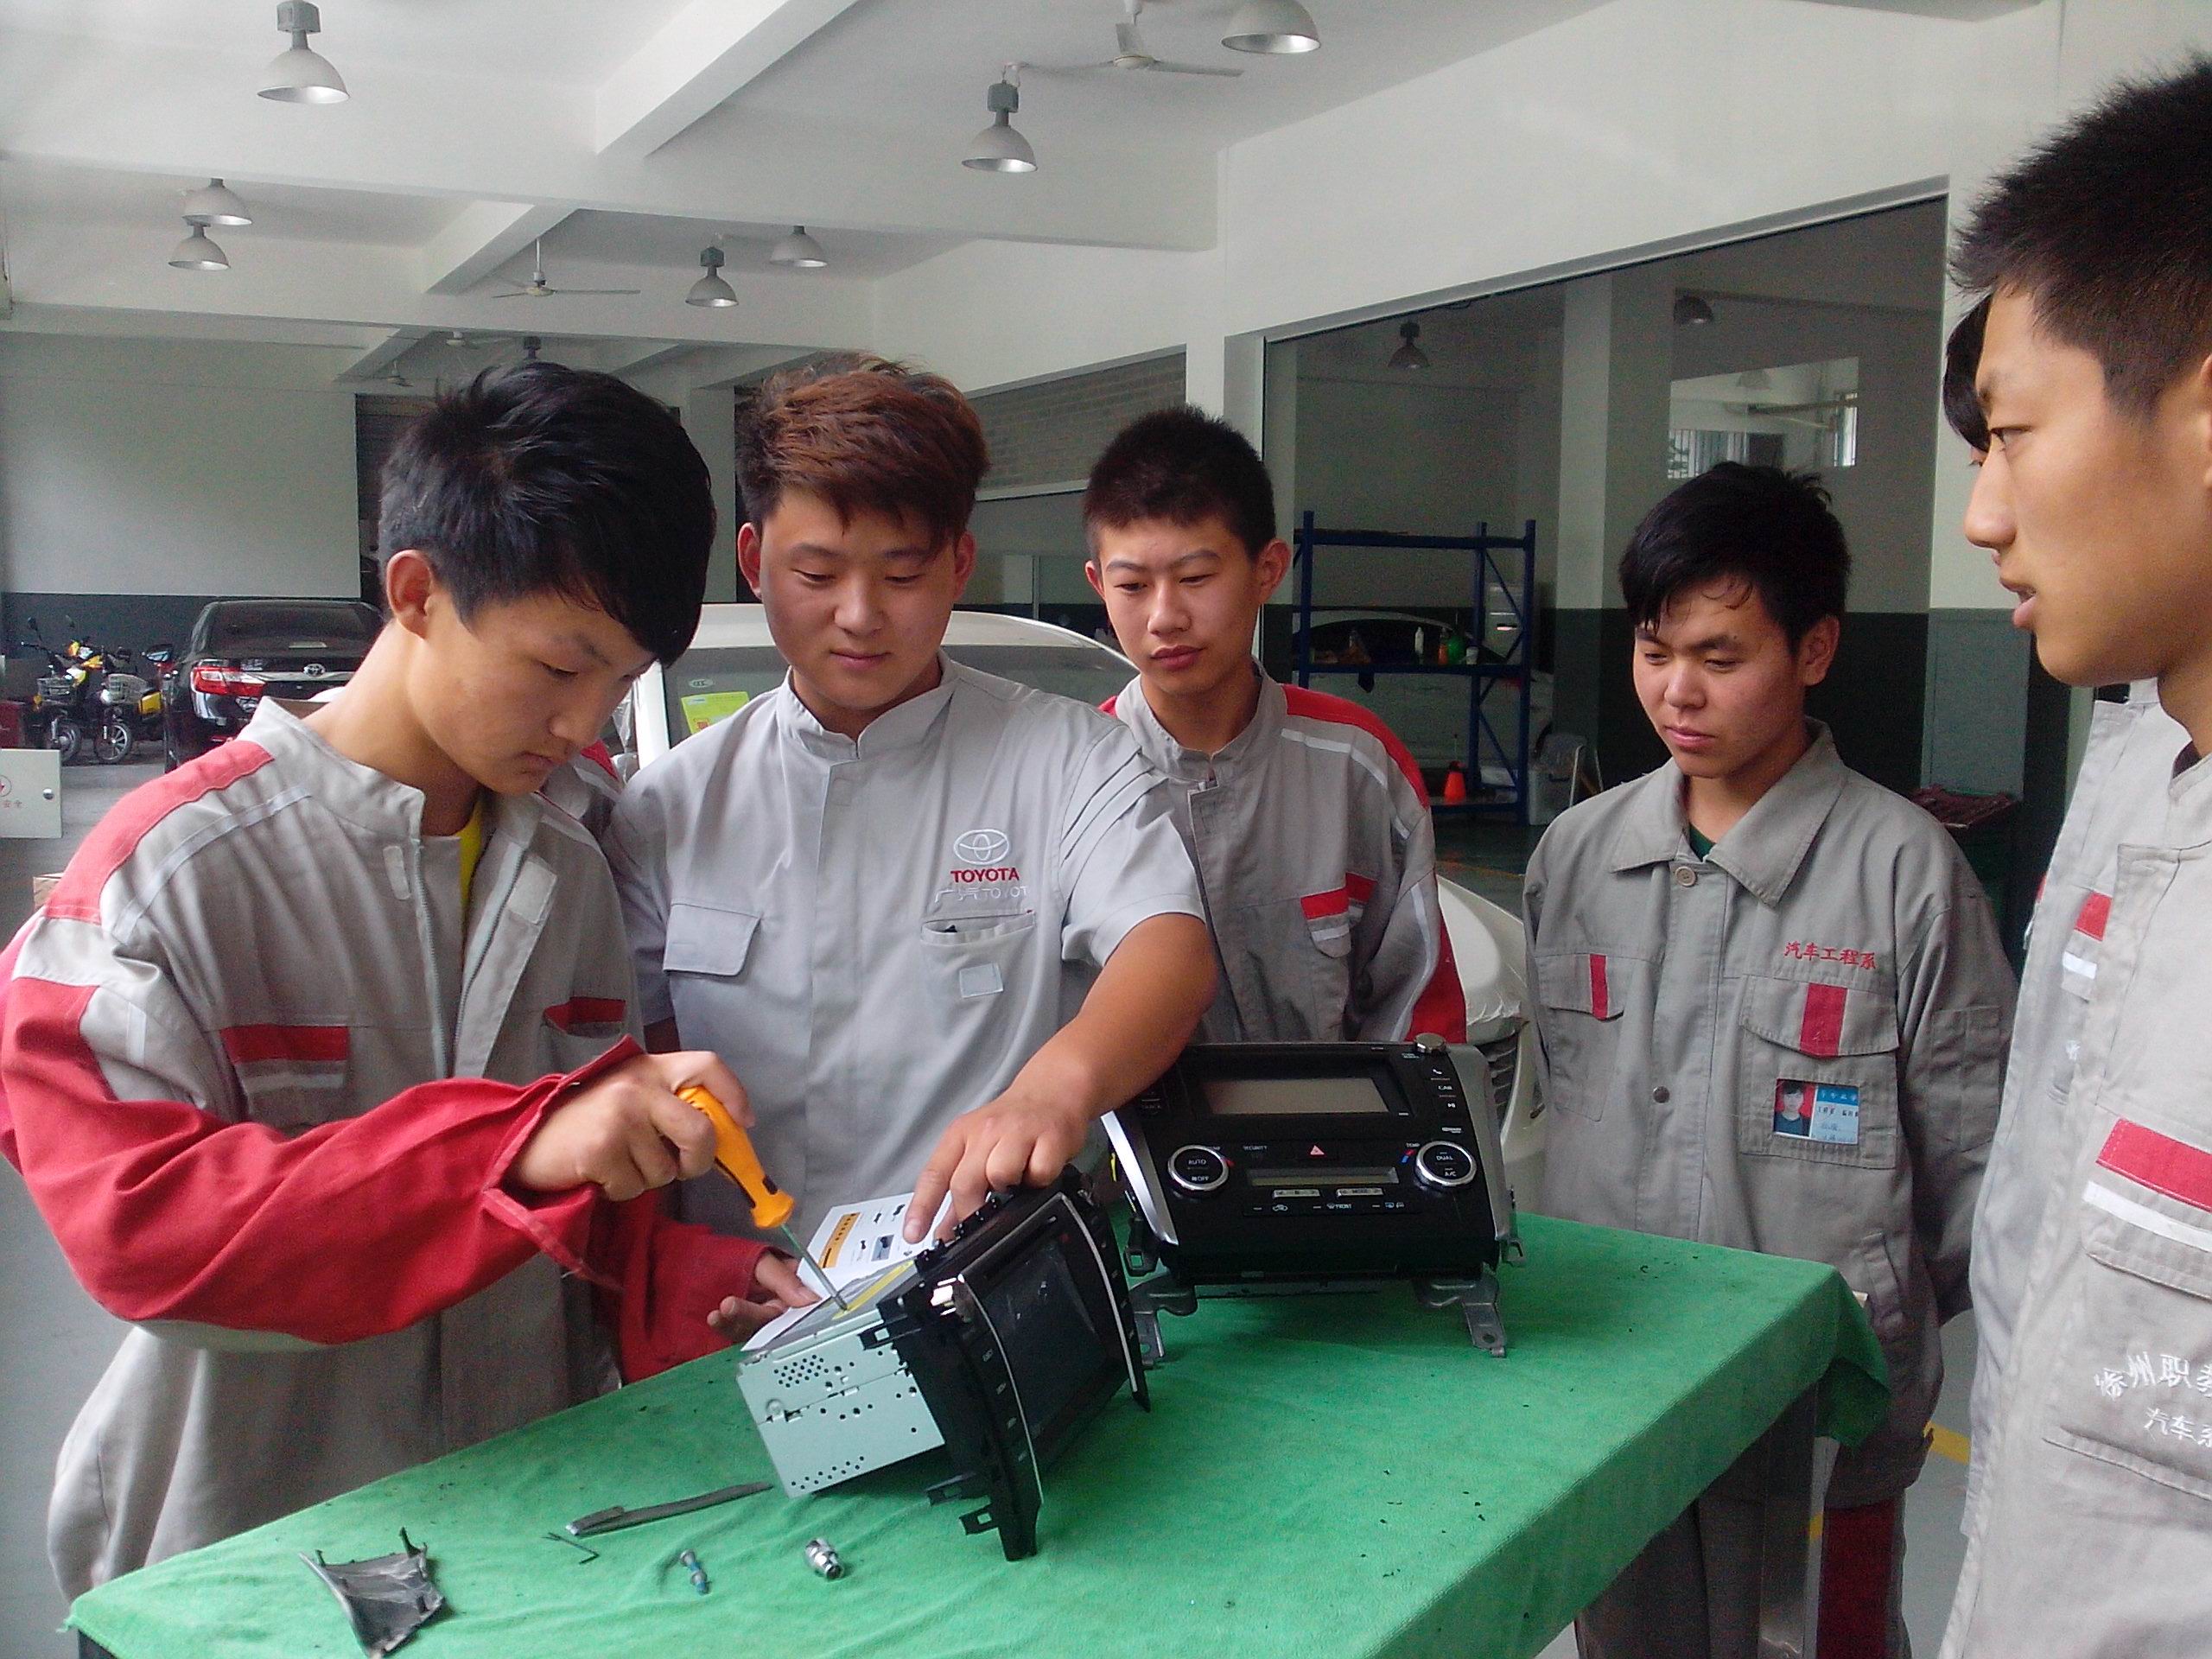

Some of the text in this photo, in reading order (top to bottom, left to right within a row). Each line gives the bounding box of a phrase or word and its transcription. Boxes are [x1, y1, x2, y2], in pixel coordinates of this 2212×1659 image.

[950, 868, 1020, 883] TOYOTA
[1783, 940, 1877, 970] 汽车工程系
